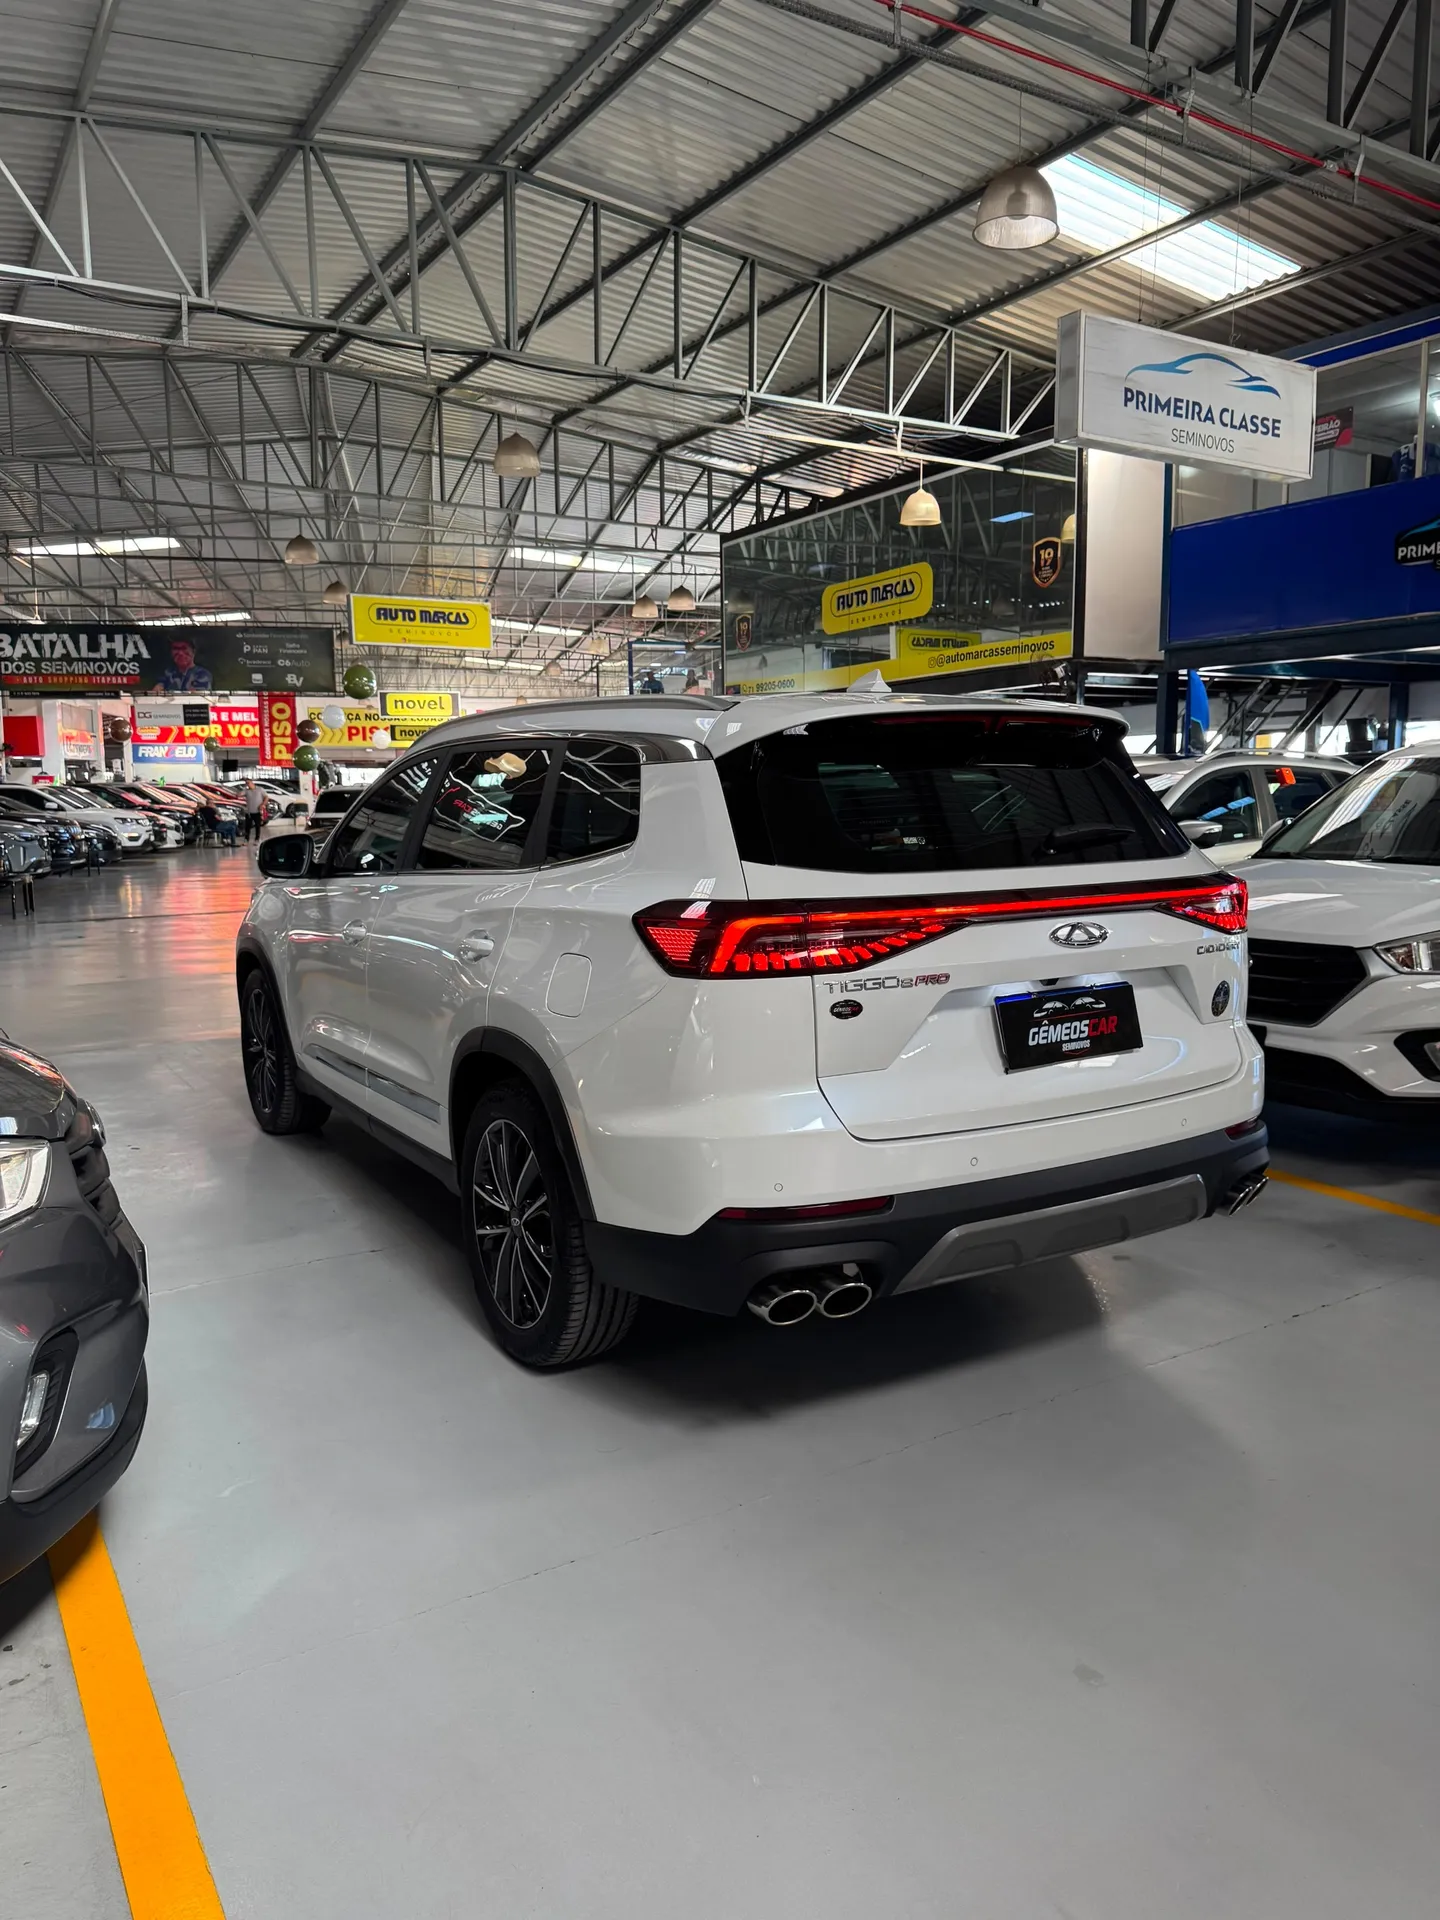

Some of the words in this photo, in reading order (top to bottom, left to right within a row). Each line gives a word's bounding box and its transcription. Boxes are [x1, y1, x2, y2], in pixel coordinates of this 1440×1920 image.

[1123, 386, 1215, 425] PRIMEIRA
[1219, 407, 1281, 438] CLASSE
[1171, 428, 1234, 453] SEMINOVOS
[837, 589, 868, 611] AUTO
[871, 578, 915, 604] MARCAS
[376, 607, 416, 622] AUTO
[419, 609, 469, 625] MARCAS
[389, 628, 459, 637] SEMINOVOS
[936, 640, 1055, 667] @automarcasseminovos
[1, 661, 36, 674] DOS
[41, 661, 140, 675] SEMINOVOS
[23, 677, 44, 685] AUTO
[48, 677, 88, 685] SHOPPING
[394, 696, 445, 710] novel
[221, 712, 229, 721] E
[184, 724, 222, 737] POR
[272, 702, 293, 760] PISO
[1061, 1040, 1091, 1052] SEMINOVOS
